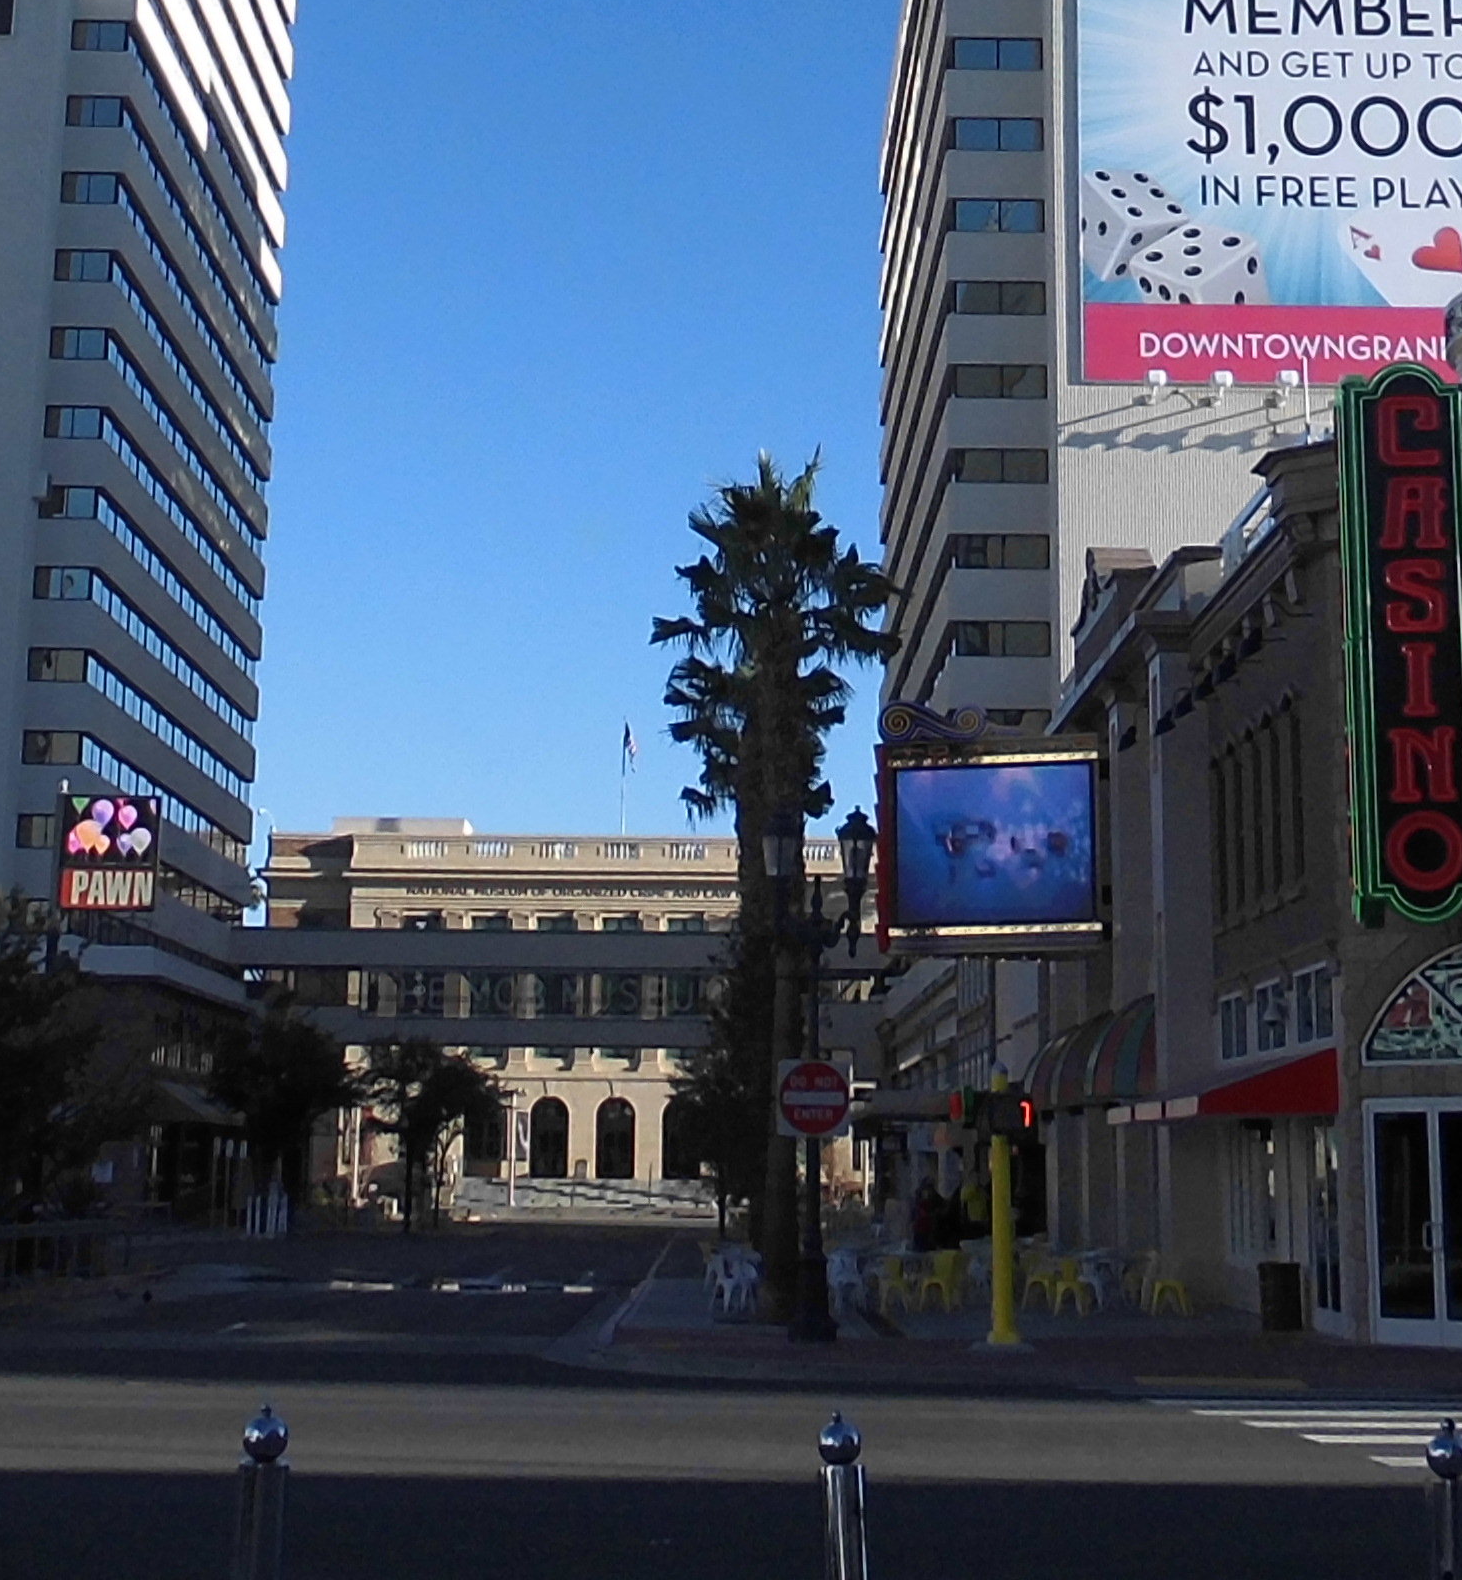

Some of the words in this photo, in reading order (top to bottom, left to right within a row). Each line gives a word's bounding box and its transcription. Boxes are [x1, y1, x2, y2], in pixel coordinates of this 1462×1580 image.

[1192, 51, 1269, 77] AND
[1281, 52, 1355, 79] GET
[1366, 53, 1412, 79] UP
[1199, 176, 1240, 207] IN
[1257, 176, 1358, 208] FREE
[1139, 331, 1447, 362] DOWNTOWNGRAN
[70, 870, 154, 906] PAWN
[789, 1074, 808, 1088] DO
[814, 1074, 838, 1088] NOT
[793, 1107, 834, 1120] ENTER
